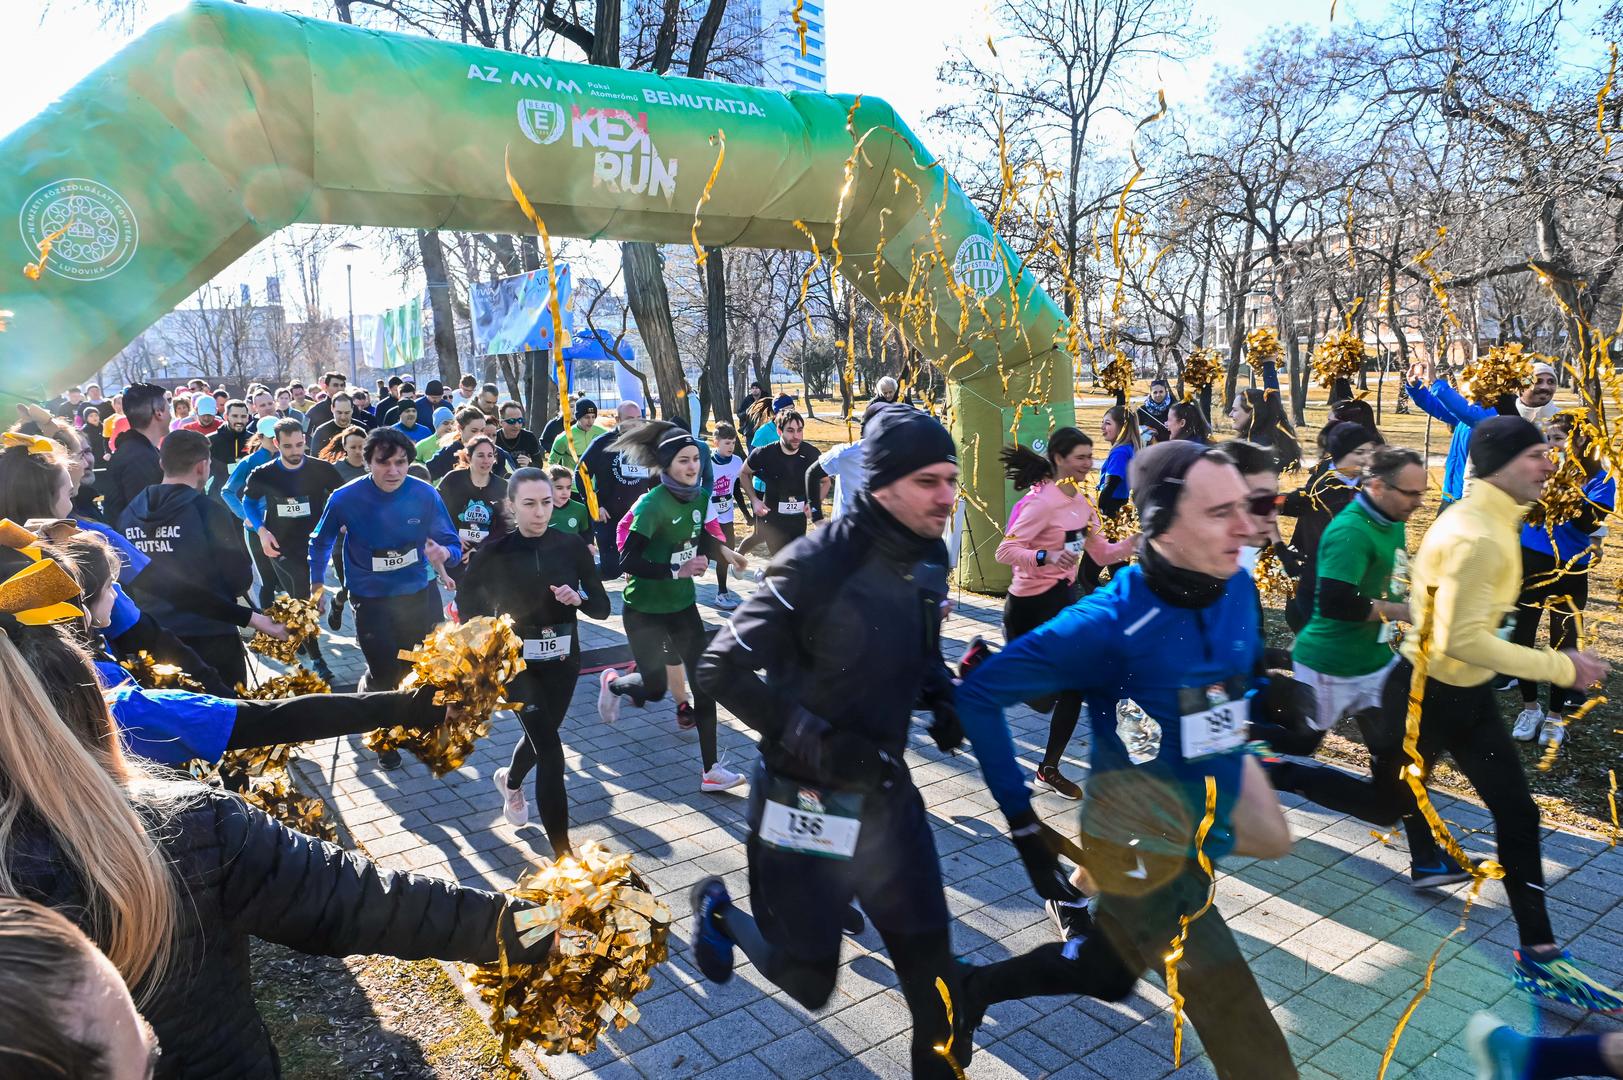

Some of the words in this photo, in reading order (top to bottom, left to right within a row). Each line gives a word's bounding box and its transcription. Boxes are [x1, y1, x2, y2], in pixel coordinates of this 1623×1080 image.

[467, 63, 502, 83] AZ
[510, 70, 582, 95] MVM
[587, 81, 611, 90] Paksi
[528, 101, 553, 111] BEAC
[641, 88, 766, 117] BEMUTATJA:
[534, 111, 549, 130] E
[592, 143, 678, 209] RUN
[27, 198, 44, 234] NEMZETI
[59, 263, 105, 275] LUDOVIKA
[286, 505, 301, 513] 218
[467, 511, 487, 520] ULTRA
[155, 525, 181, 538] BEAC
[467, 531, 481, 540] 166
[135, 540, 174, 552] FUTSAL
[384, 557, 404, 567] 180
[539, 640, 556, 651] 116
